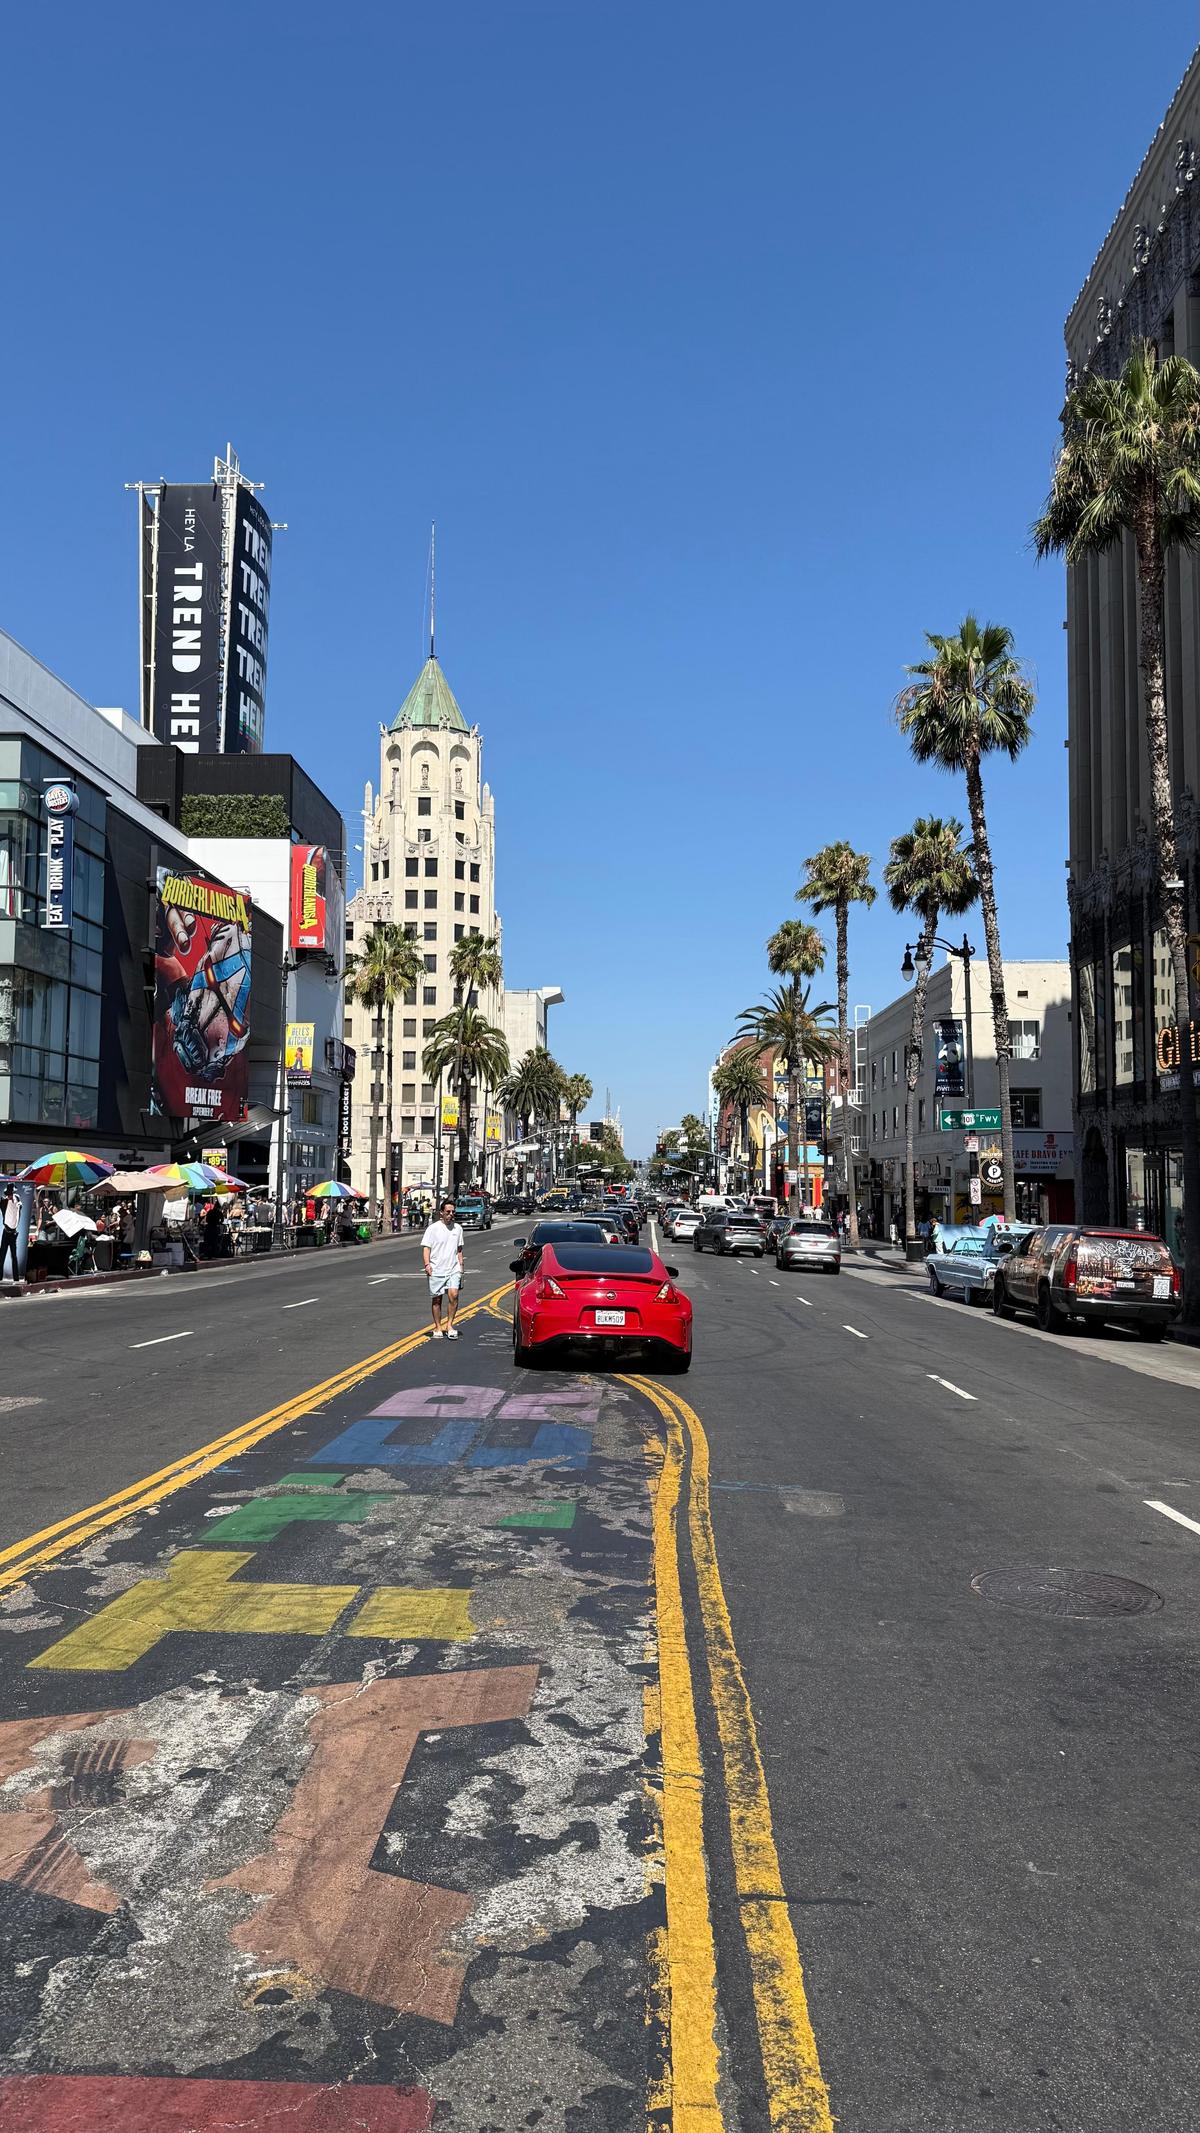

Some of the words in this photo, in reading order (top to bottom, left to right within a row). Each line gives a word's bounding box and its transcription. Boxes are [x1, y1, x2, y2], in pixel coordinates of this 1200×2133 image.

[184, 509, 196, 533] HEY
[184, 537, 195, 552] LA
[172, 562, 203, 673] TREND
[50, 818, 64, 844] PLAY
[50, 858, 63, 890] DRINK
[162, 876, 237, 923] BORDERLANDS
[304, 864, 317, 919] BORDERLANDS
[50, 903, 63, 922] EAT
[185, 1086, 207, 1105] BREAK
[207, 1088, 222, 1106] FREE
[980, 1114, 998, 1124] Fwy
